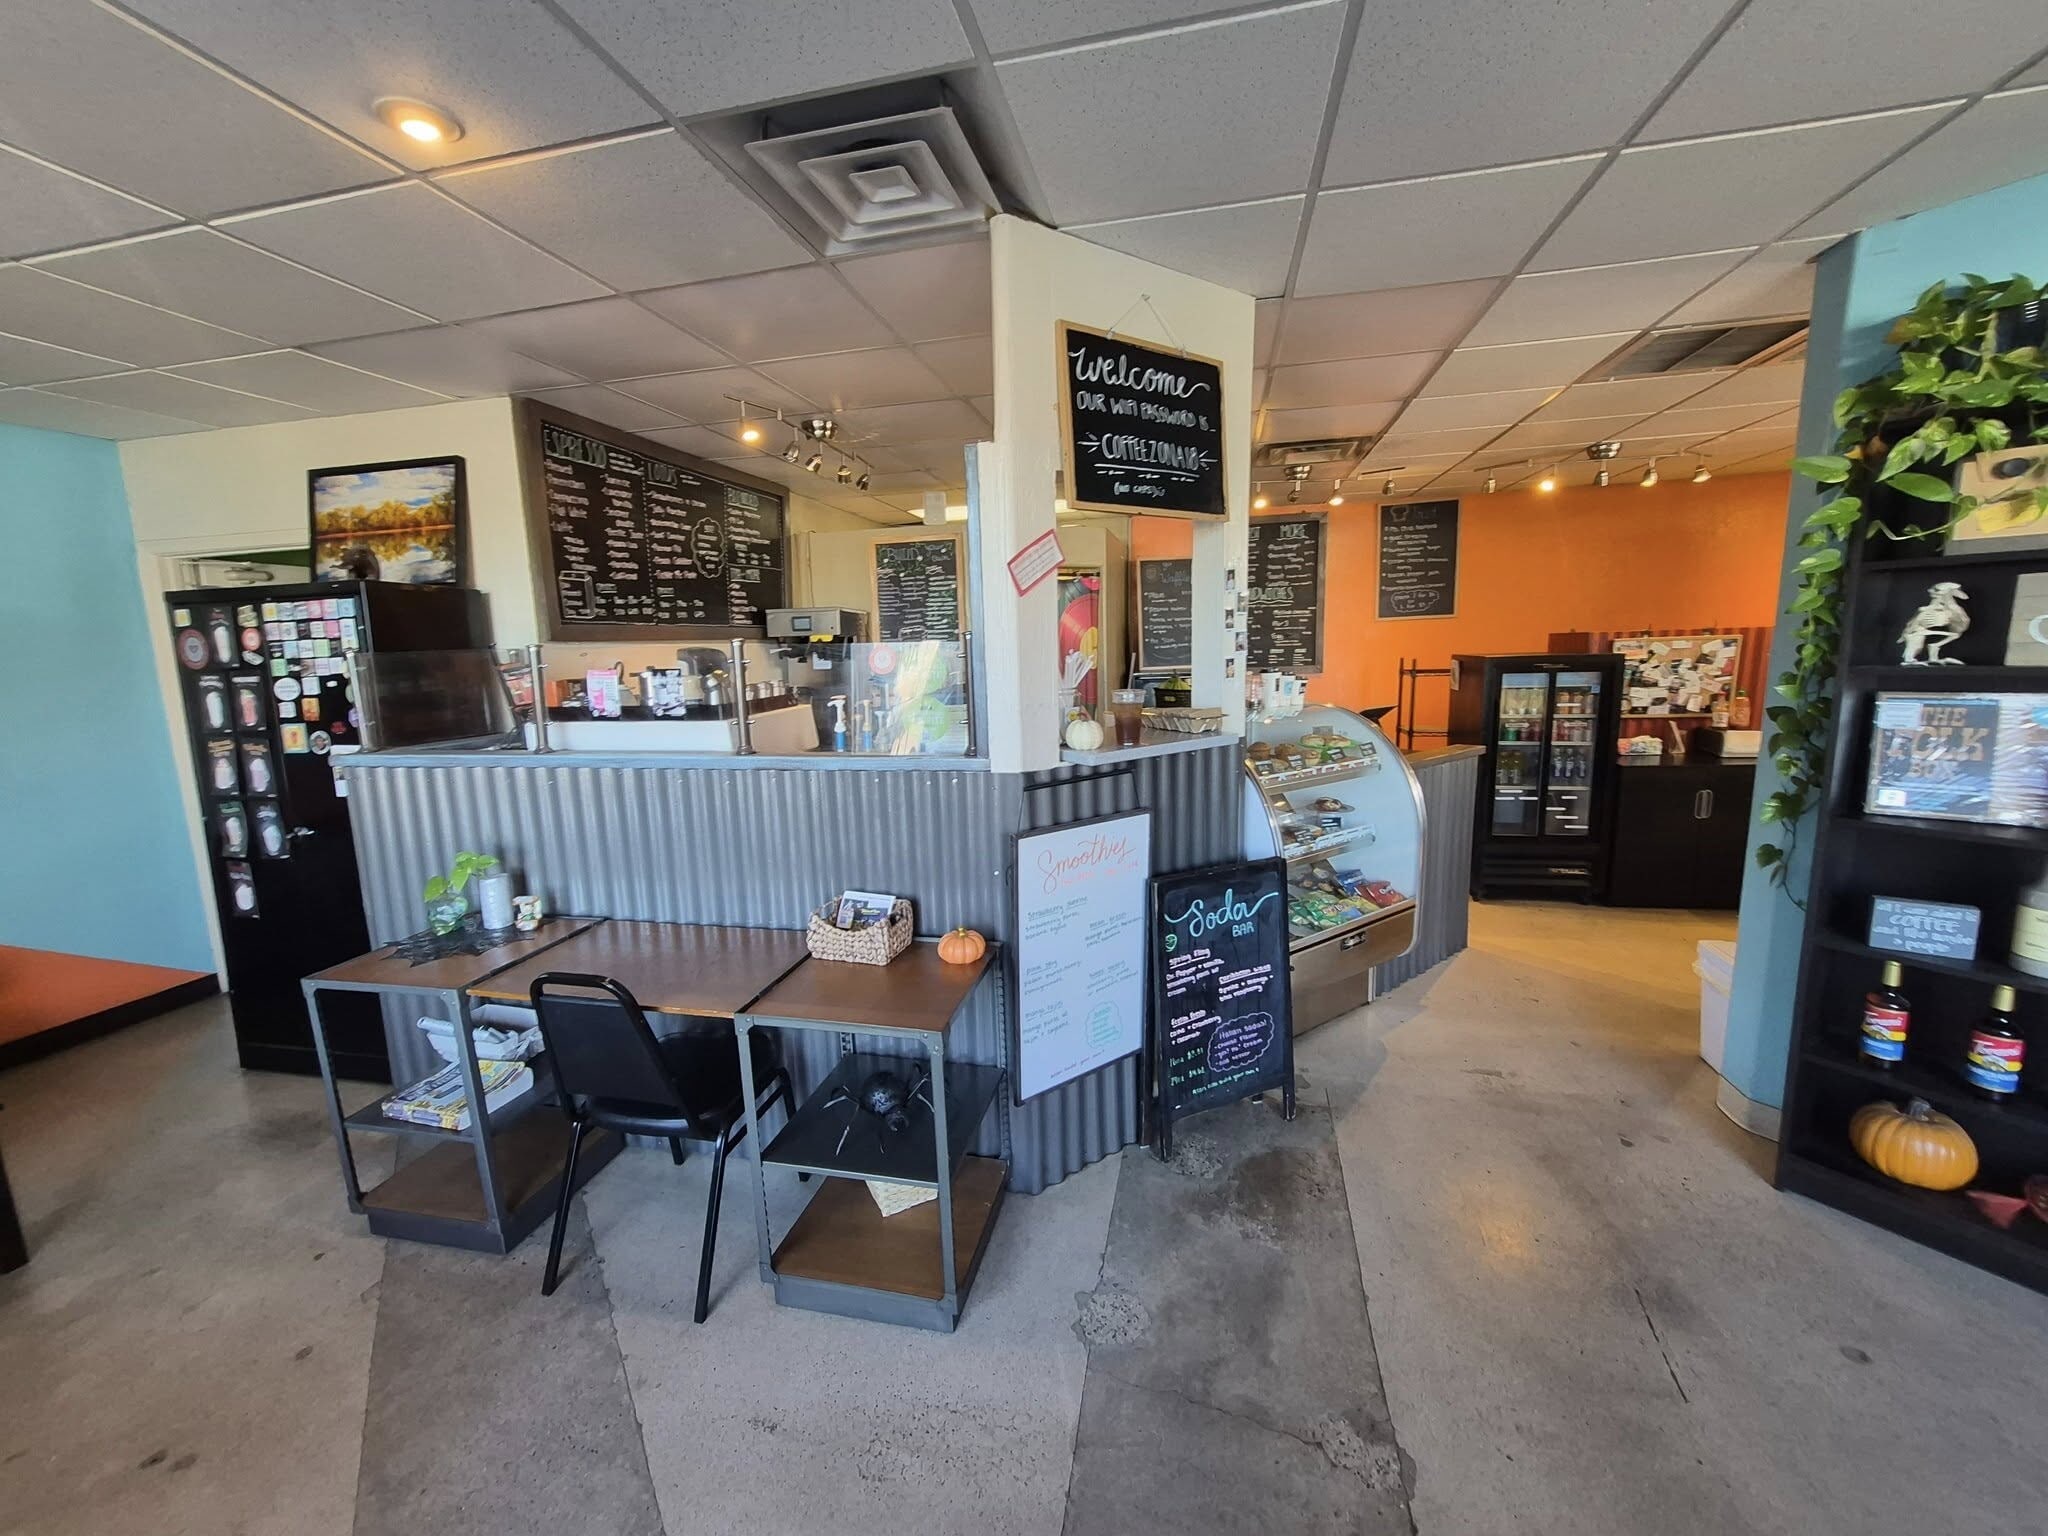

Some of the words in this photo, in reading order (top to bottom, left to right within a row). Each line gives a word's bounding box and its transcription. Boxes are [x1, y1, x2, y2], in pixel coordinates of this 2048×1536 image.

[1068, 347, 1211, 398] Welcome
[1076, 391, 1106, 412] OUR
[1037, 834, 1136, 895] Smoothies
[1164, 888, 1279, 937] Soda
[1232, 922, 1254, 938] BAR
